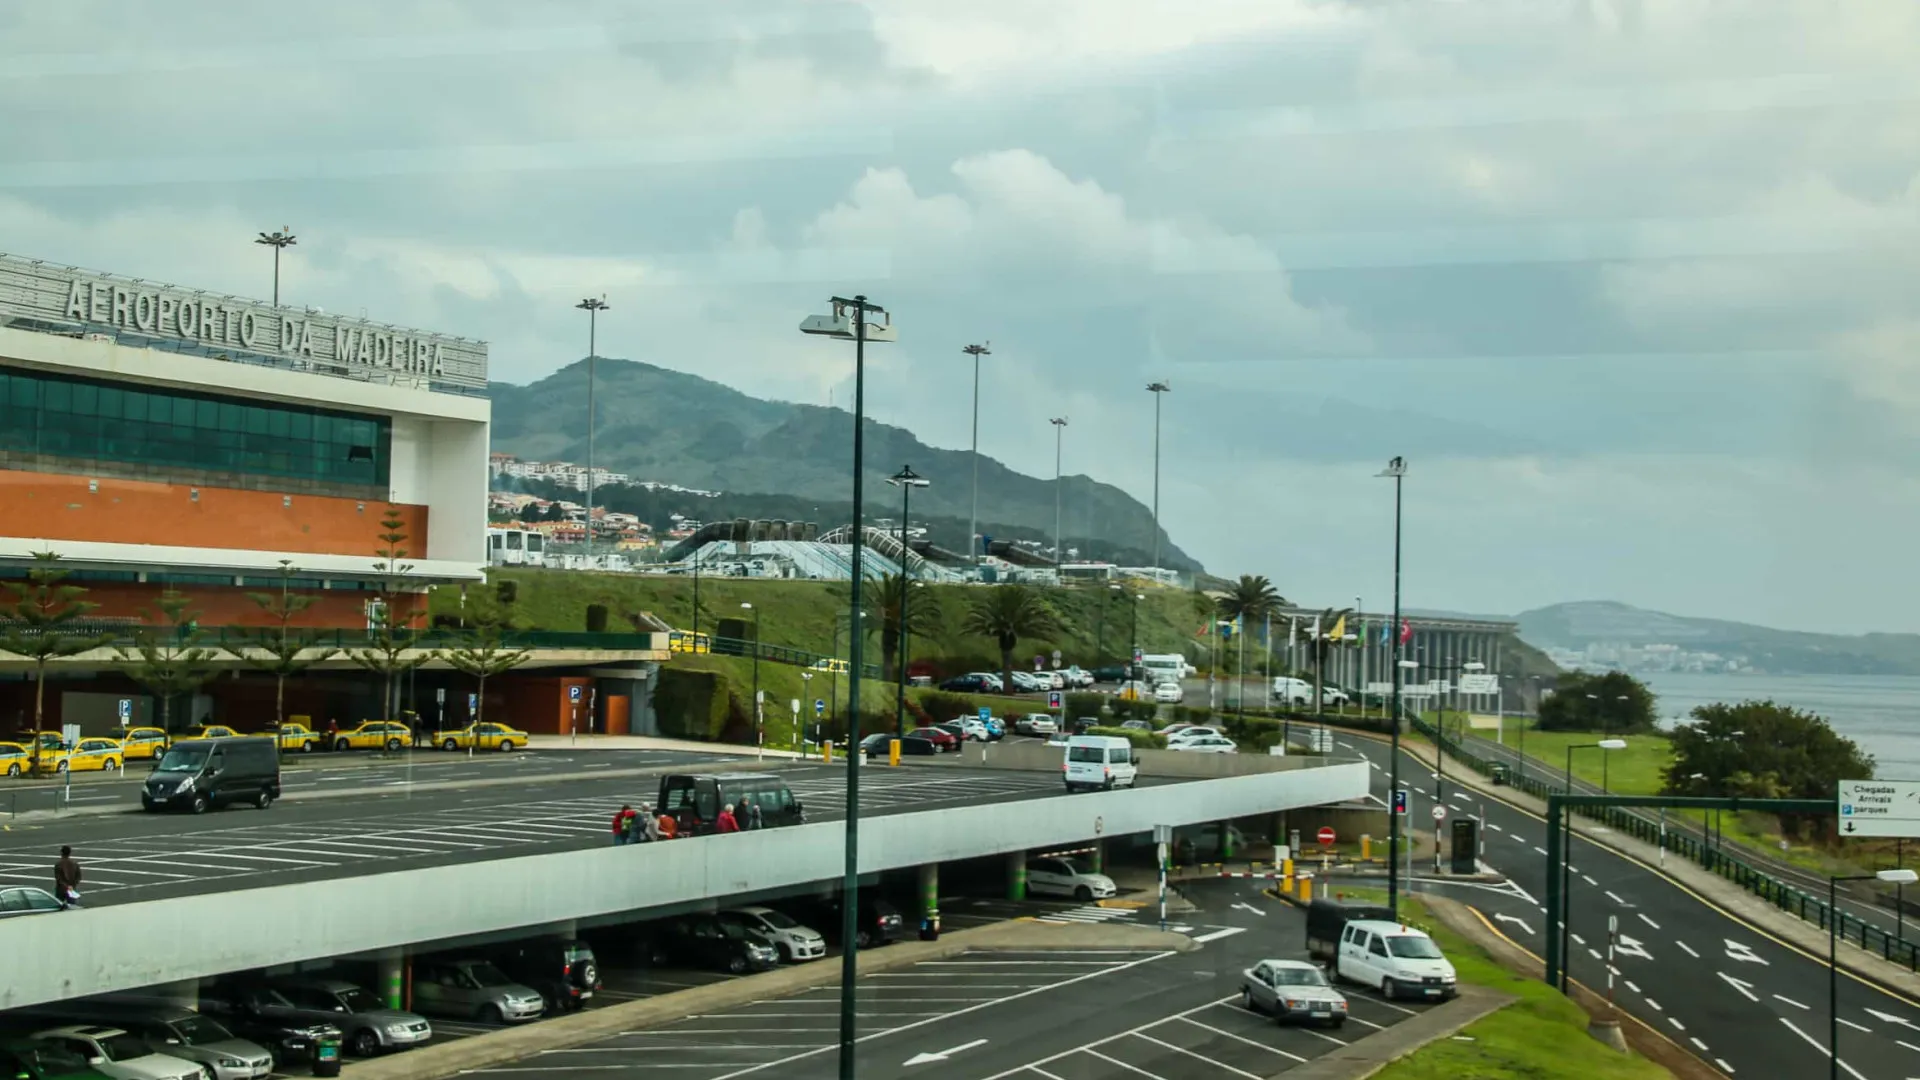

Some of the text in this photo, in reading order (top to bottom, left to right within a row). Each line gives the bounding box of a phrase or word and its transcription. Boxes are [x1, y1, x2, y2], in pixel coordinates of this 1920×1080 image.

[66, 279, 445, 377] AEROPORTO DA MADEIRA
[571, 687, 579, 698] P
[1854, 785, 1896, 794] Chegadas
